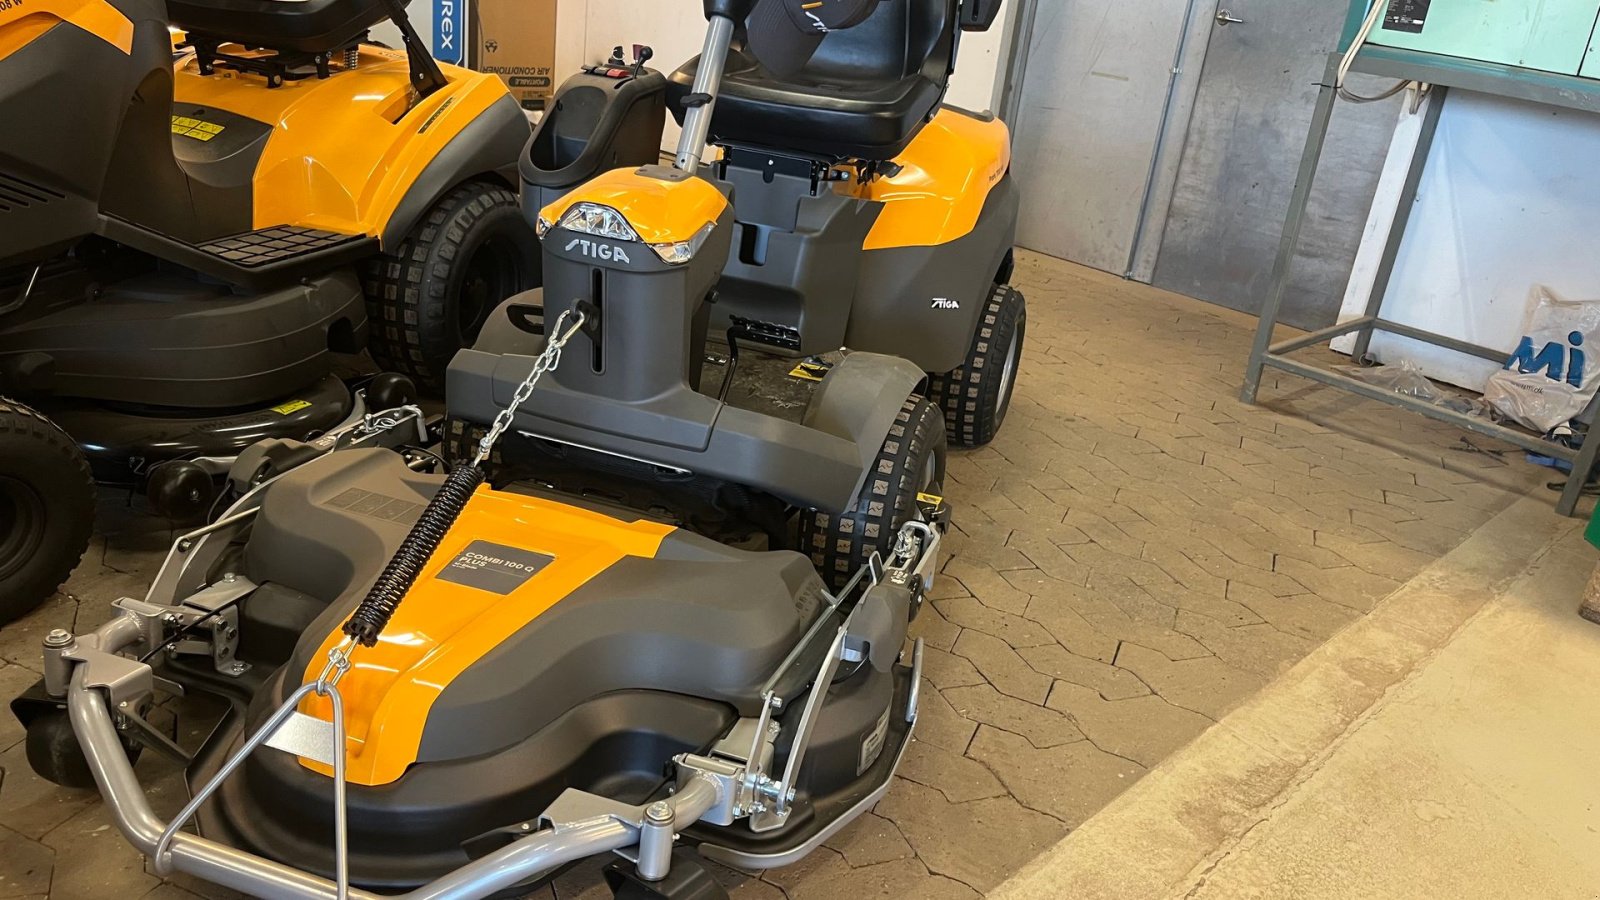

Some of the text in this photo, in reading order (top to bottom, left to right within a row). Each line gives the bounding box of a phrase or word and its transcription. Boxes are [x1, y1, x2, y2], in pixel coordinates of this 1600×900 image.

[0, 0, 12, 12] 08
[482, 66, 551, 75] AIR CONDITIONER
[565, 239, 630, 264] STIGA
[931, 297, 960, 309] STIGA
[458, 557, 487, 567] PLUS
[465, 552, 504, 565] COMBI
[504, 561, 524, 570] 100
